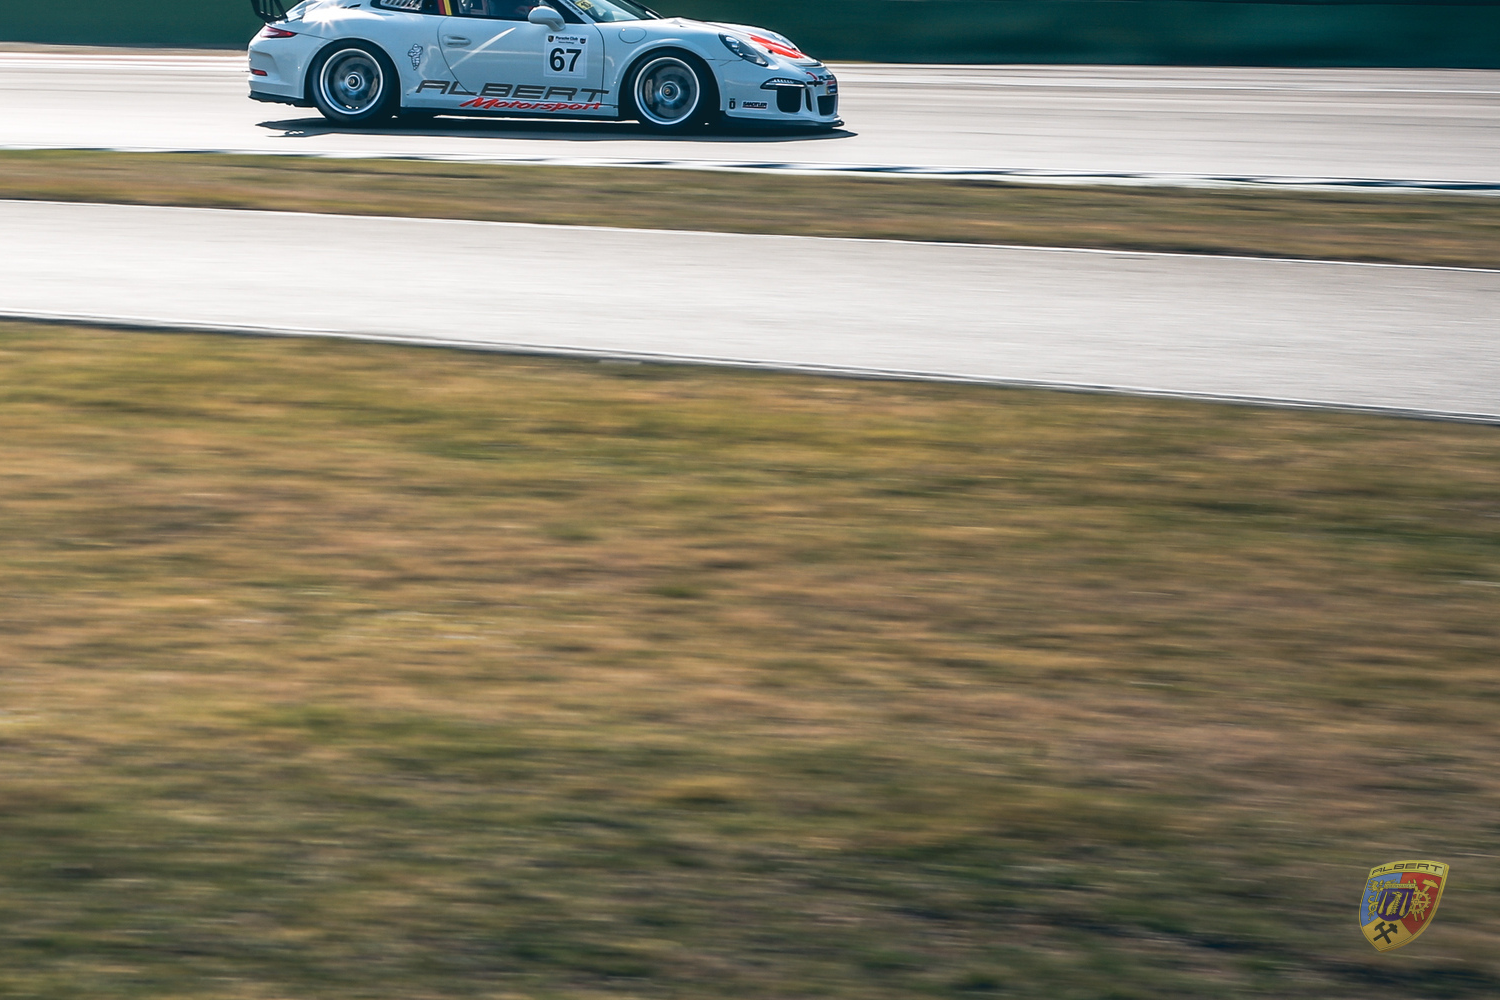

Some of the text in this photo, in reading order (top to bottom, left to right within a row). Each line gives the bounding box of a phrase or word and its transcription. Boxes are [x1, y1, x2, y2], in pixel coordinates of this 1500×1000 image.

[549, 47, 582, 72] 67
[415, 79, 610, 103] ALBERT
[458, 96, 602, 112] Motorsport
